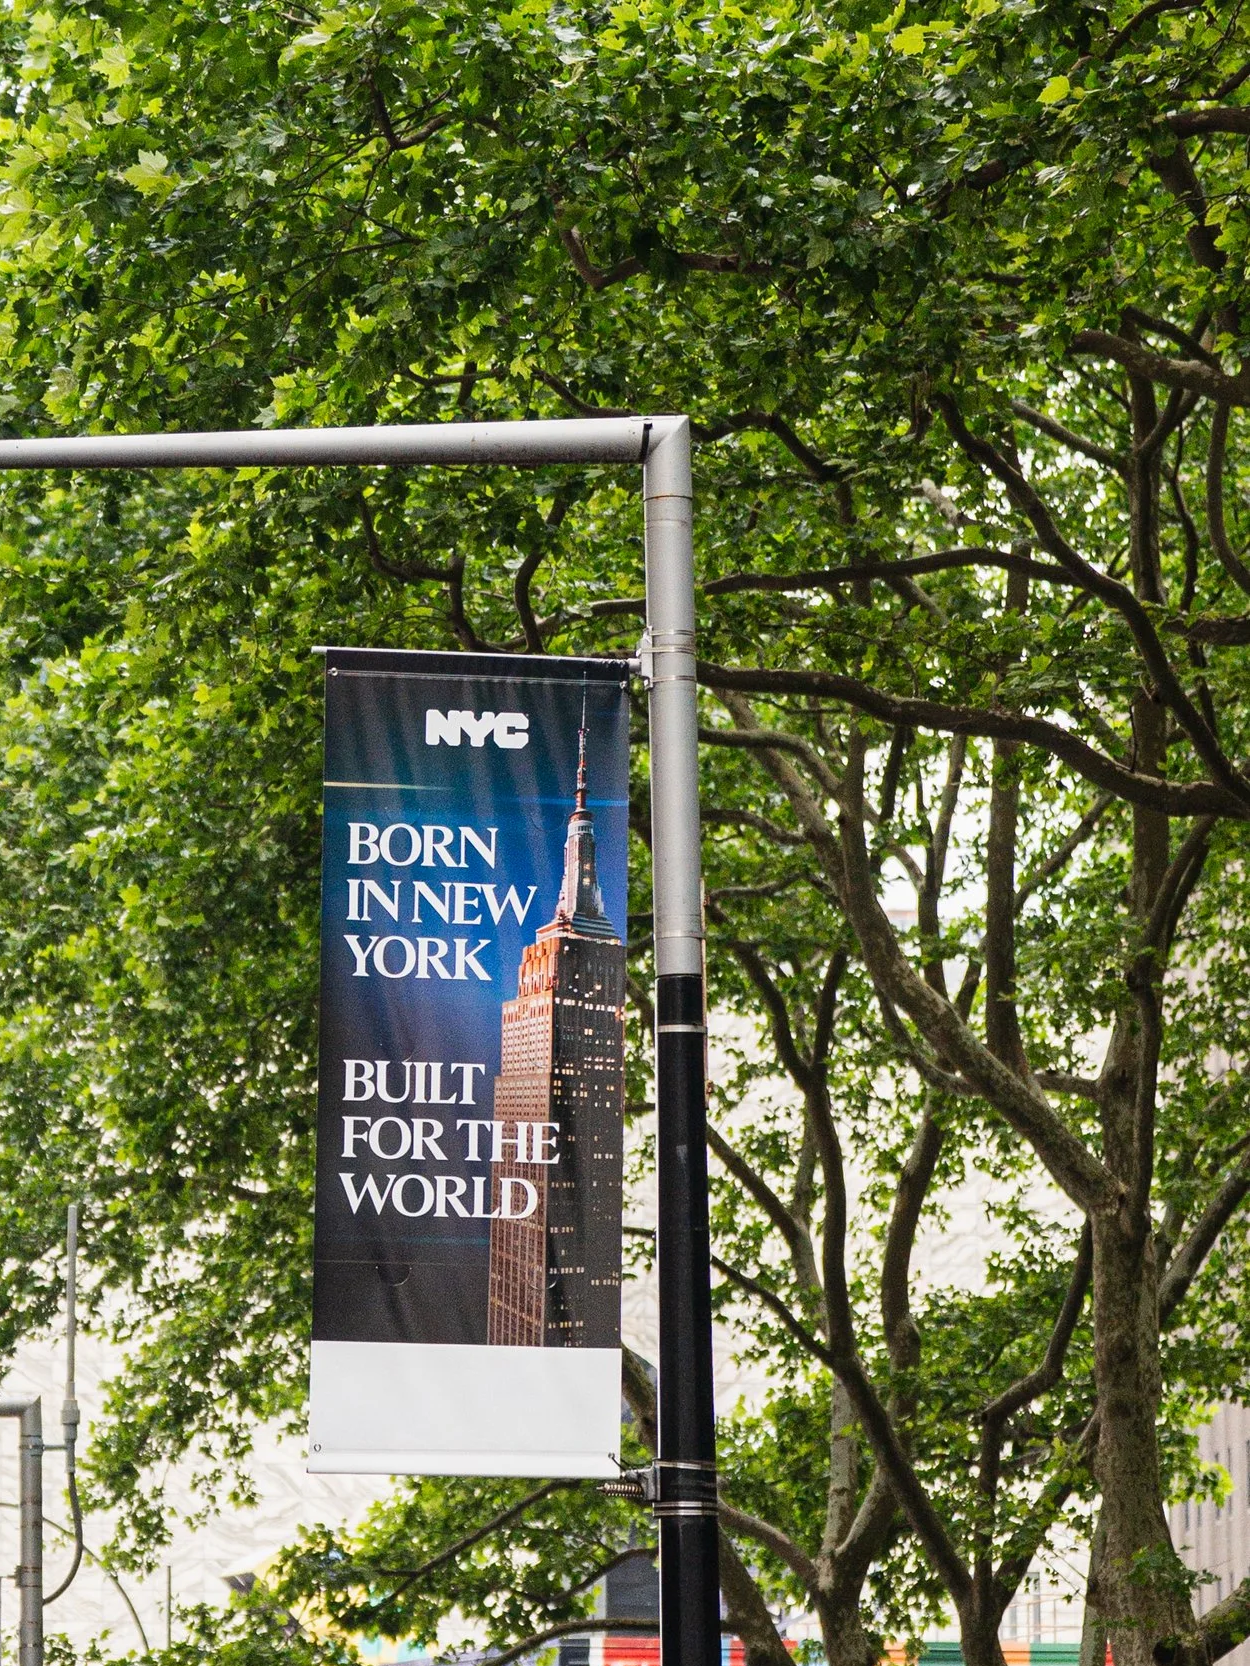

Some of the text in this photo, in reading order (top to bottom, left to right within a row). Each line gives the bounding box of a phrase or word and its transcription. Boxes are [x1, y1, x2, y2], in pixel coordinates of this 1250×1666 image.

[426, 709, 529, 749] NYC
[347, 822, 498, 869] BORN
[346, 879, 538, 927] IN NEW
[343, 935, 492, 981] YORK
[342, 1059, 486, 1105] BUILT
[341, 1116, 560, 1164] FOR THE
[338, 1172, 538, 1220] WORLD
